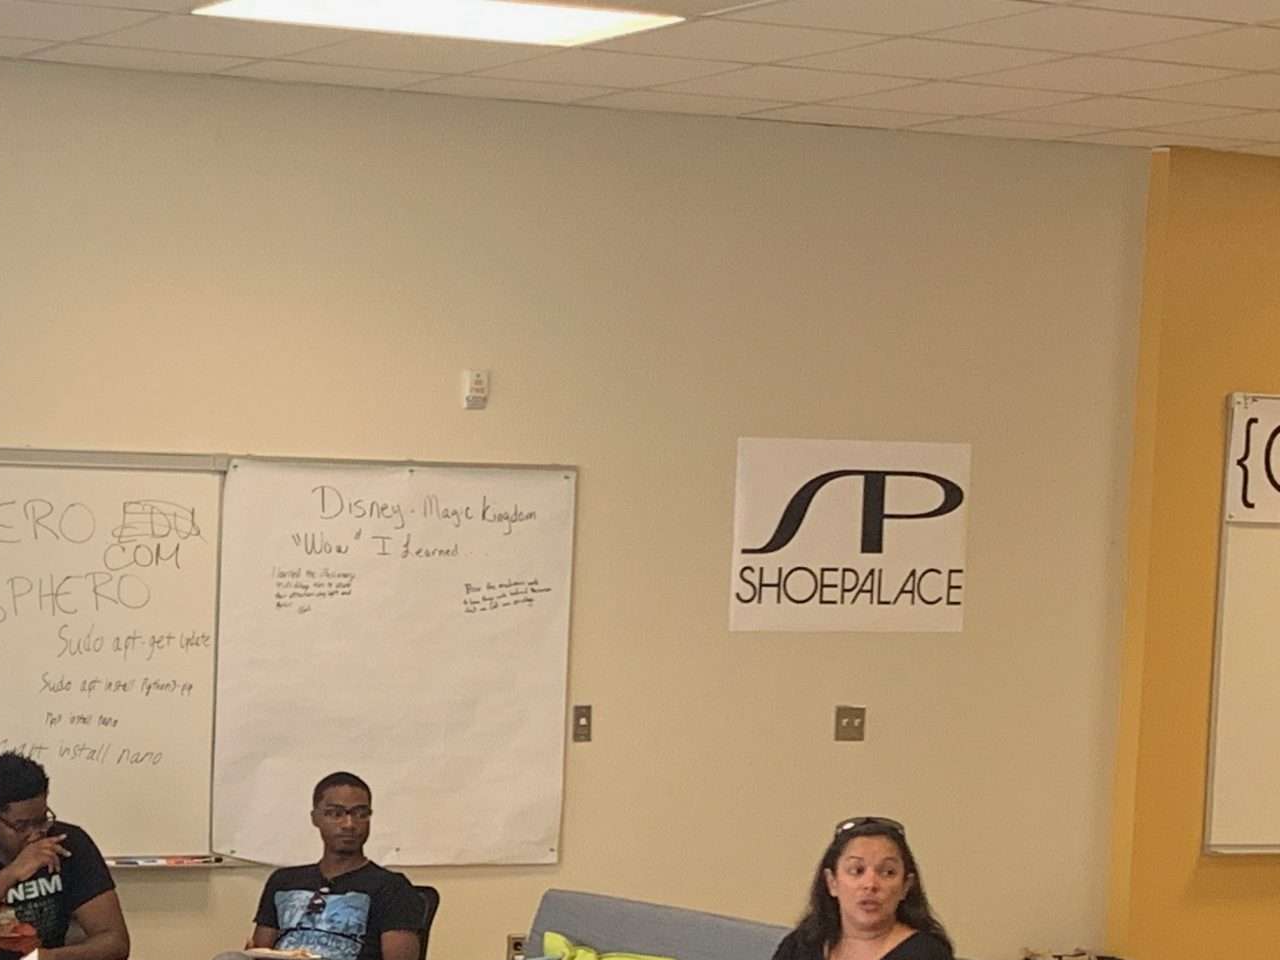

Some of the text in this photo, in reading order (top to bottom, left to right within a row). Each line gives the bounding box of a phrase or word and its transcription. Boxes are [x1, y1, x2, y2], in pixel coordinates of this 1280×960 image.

[311, 485, 406, 530] Disney
[423, 496, 473, 528] Magic
[104, 543, 180, 571] COM
[371, 536, 394, 556] I
[734, 565, 965, 606] SHOEPALACE
[58, 743, 111, 764] install
[116, 748, 164, 765] nano
